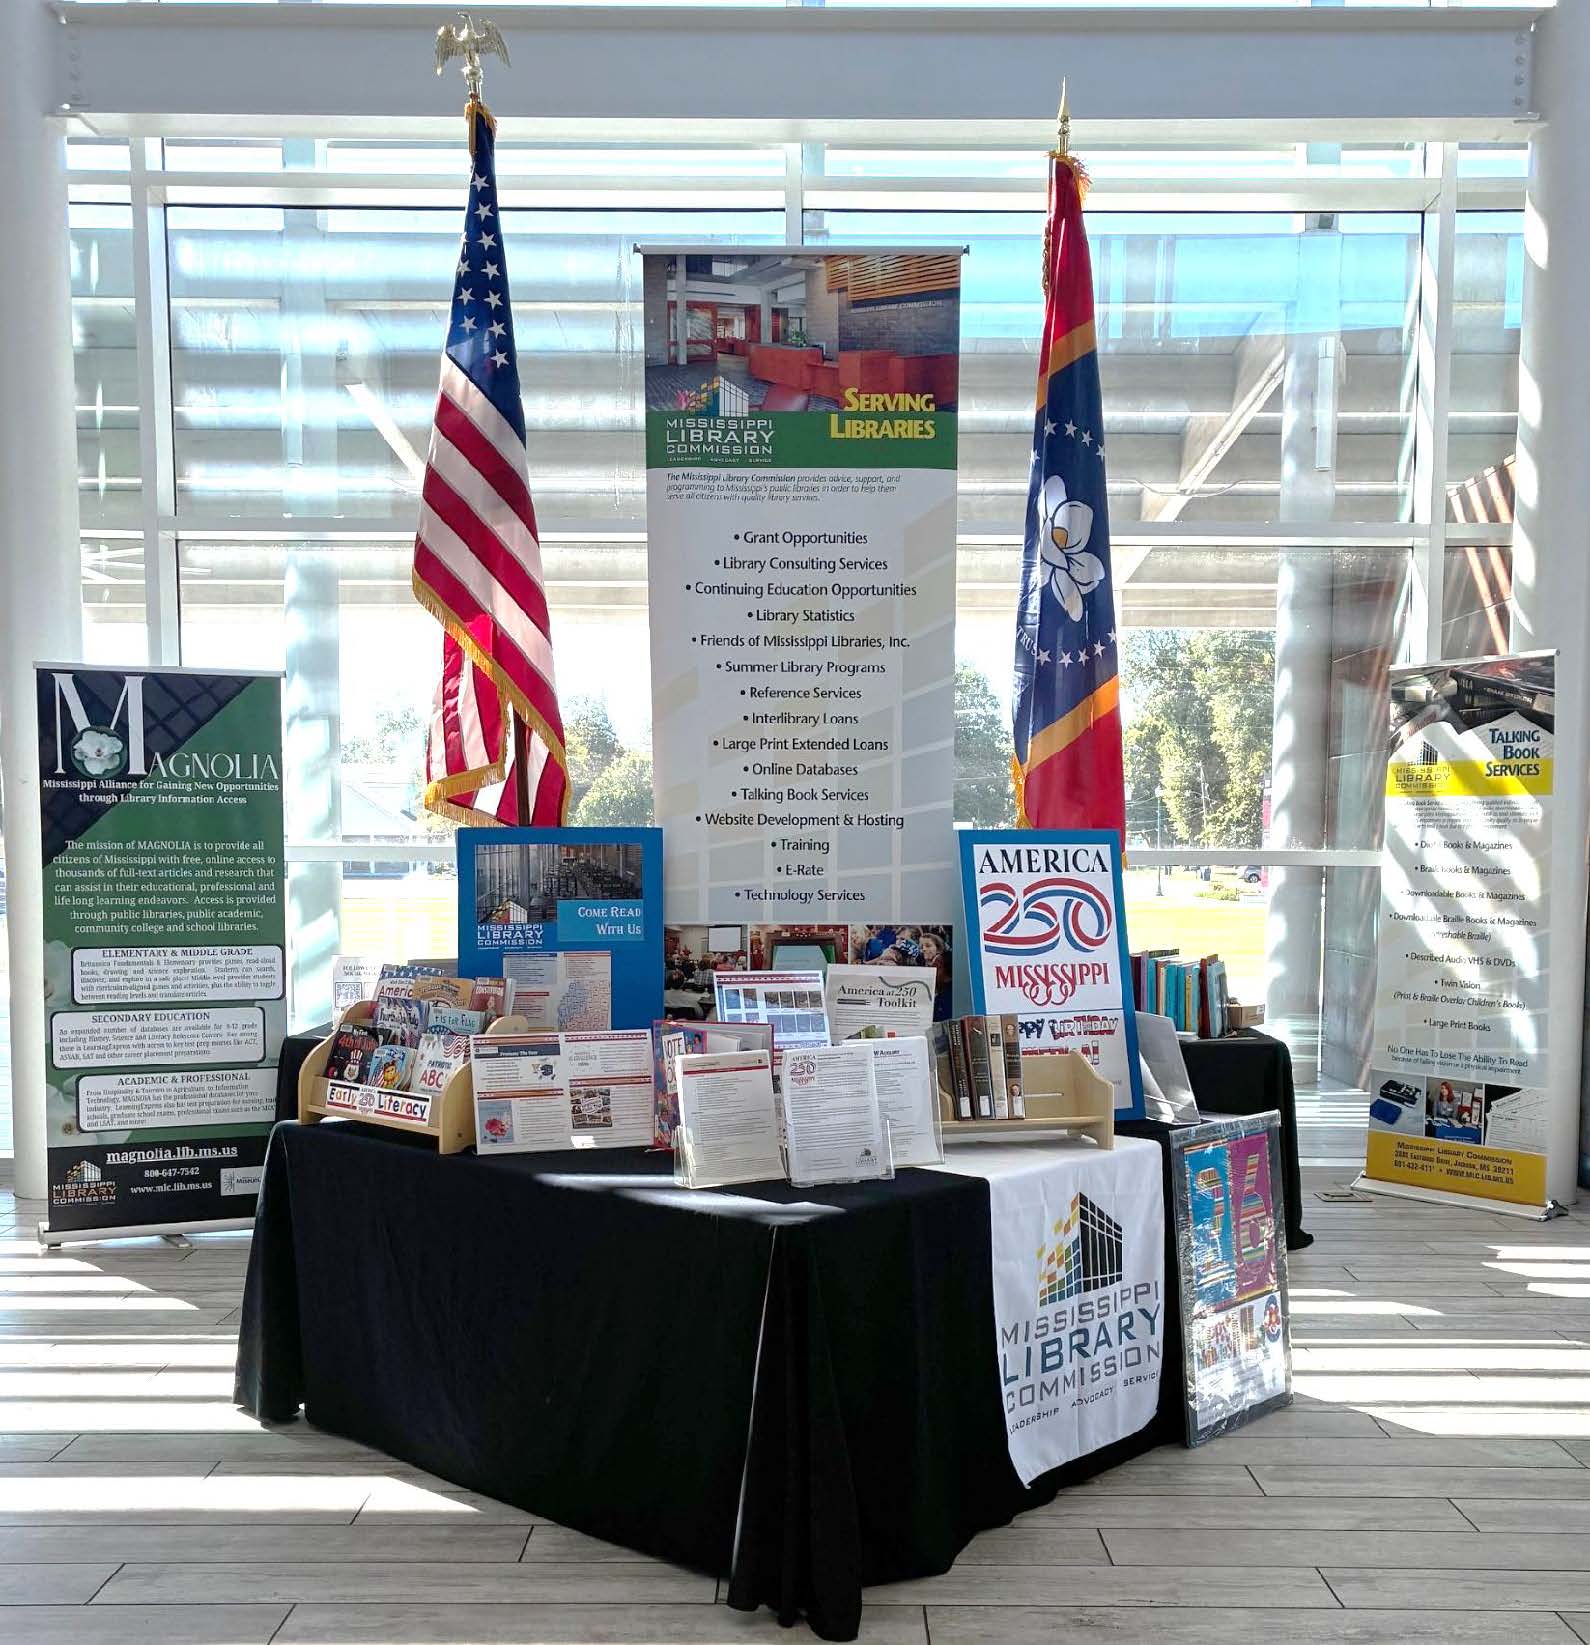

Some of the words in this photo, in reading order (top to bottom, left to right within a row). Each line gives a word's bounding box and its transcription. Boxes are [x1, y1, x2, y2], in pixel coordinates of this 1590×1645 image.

[844, 388, 935, 411] SERVING
[667, 419, 772, 429] MISSISSIPPI
[830, 414, 935, 439] LIBRARIES
[667, 430, 774, 443] LIBRARY
[667, 445, 772, 454] COMMISSION
[744, 532, 780, 544] Grant
[782, 532, 868, 547] Opportunities
[723, 558, 765, 573] Library
[770, 558, 836, 573] Consulting
[839, 558, 888, 570] Services
[695, 582, 763, 598] Continuing
[767, 583, 827, 595] Education
[832, 584, 917, 599] Opportunities
[756, 610, 799, 624] Library
[803, 610, 855, 622] Statistics
[701, 635, 744, 646] Friends
[748, 635, 760, 647] of
[764, 635, 828, 651] Mississippi
[832, 636, 885, 649] Libraries,
[889, 637, 910, 648] Inc.
[1017, 626, 1037, 656] TRUS
[725, 662, 777, 673] Summer
[780, 662, 823, 676] Library
[827, 662, 885, 675] Programs
[750, 688, 810, 698] Reference
[814, 688, 862, 698] Services
[51, 672, 278, 779] MAGNOLIA
[752, 713, 819, 727] Interlibrary
[823, 714, 858, 724] Loans
[1489, 728, 1540, 743] TALKING
[722, 739, 756, 752] Large
[760, 739, 788, 750] Print
[792, 739, 849, 750] Extended
[853, 740, 888, 750] Loans
[1503, 745, 1540, 759] BOOK
[753, 764, 792, 775] Online
[796, 764, 858, 775] Databases
[1486, 762, 1539, 777] SERVICES
[1396, 774, 1450, 782] LIBRARY
[43, 779, 97, 790] Mississippi
[99, 780, 137, 789] Alliance
[140, 780, 154, 789] for
[156, 781, 192, 792] Gaining
[195, 782, 214, 790] New
[216, 782, 279, 792] Opportunities
[79, 793, 117, 804] through
[120, 793, 155, 804] Library
[158, 795, 214, 804] Information
[217, 795, 247, 804] Access
[741, 789, 783, 803] Talking
[787, 790, 817, 800] Book
[821, 790, 868, 801] Services
[705, 814, 754, 825] Website
[757, 815, 840, 829] Development
[844, 815, 853, 825] &
[857, 815, 904, 829] Hosting
[65, 840, 84, 849] The
[87, 842, 123, 850] mission
[126, 840, 136, 849] of
[138, 841, 191, 849] MAGNOLIA
[194, 842, 201, 850] is
[204, 842, 213, 850] to
[215, 841, 249, 853] provide
[253, 841, 264, 849] all
[781, 839, 829, 854] Training
[1465, 841, 1471, 849] &
[1473, 841, 1512, 851] Magazines
[53, 855, 89, 864] citizens
[93, 855, 102, 864] of
[104, 855, 156, 867] Mississippi
[158, 855, 180, 864] with
[206, 855, 234, 864] online
[237, 856, 265, 864] access
[267, 856, 275, 864] to
[978, 849, 1109, 874] AMERICA
[55, 868, 104, 877] thousands
[107, 868, 118, 877] of
[120, 868, 156, 877] full-text
[158, 868, 192, 877] articles
[195, 868, 212, 877] and
[215, 868, 253, 877] research
[256, 869, 273, 877] that
[786, 865, 824, 875] E-Rate
[744, 890, 814, 903] Technology
[817, 890, 865, 901] Services
[578, 907, 607, 917] COME
[611, 906, 640, 917] READ
[980, 878, 1112, 956] 250
[1443, 915, 1464, 923] Braille
[1465, 916, 1487, 924] Books
[1490, 917, 1495, 925] &
[1498, 917, 1536, 927] Magazines
[75, 924, 129, 934] community
[132, 923, 163, 934] college
[167, 923, 184, 932] and
[186, 923, 215, 932] school
[218, 922, 258, 932] libraries.
[597, 924, 624, 934] WITH
[628, 924, 640, 934] US
[478, 931, 544, 939] LIBRARY
[102, 949, 167, 958] ELEMENTARY
[171, 949, 178, 957] &
[181, 949, 217, 957] MIDDLE
[1411, 952, 1444, 962] Described
[1469, 956, 1484, 964] VHS
[1494, 958, 1515, 968] DVDs
[995, 963, 1110, 1006] MISSISSIPPI
[1440, 979, 1458, 987] Twin
[1460, 981, 1480, 989] Vision
[379, 985, 412, 998] Americ
[837, 985, 884, 997] America
[895, 986, 916, 997] 250
[877, 998, 916, 1008] Toolkit
[92, 1014, 150, 1023] SECONDARY
[154, 1012, 210, 1022] EDUCATION
[1019, 1018, 1045, 1038] PPY
[1429, 1018, 1448, 1028] Large
[1450, 1019, 1466, 1029] Print
[1468, 1021, 1491, 1031] Books
[118, 1076, 169, 1086] ACADEMIC
[181, 1072, 250, 1083] PROFESSIONAL
[330, 1088, 357, 1104] Early
[378, 1093, 427, 1118] Literacy
[106, 1147, 238, 1164] magnolia.lib.ms.us
[145, 1167, 200, 1178] 800-647-7542
[53, 1181, 116, 1190] MISSISSIPPI
[131, 1182, 212, 1194] www.mlc.lib.ms.us
[53, 1188, 116, 1198] LIBRARY
[53, 1195, 116, 1204] COMMISSION
[1001, 1281, 1159, 1348] MISSISSIPPI
[1003, 1303, 1160, 1386] LIBRARY
[1005, 1342, 1160, 1414] COMMISSION
[1071, 1386, 1113, 1408] ADVOCACY
[1123, 1369, 1159, 1387] SERVIC
